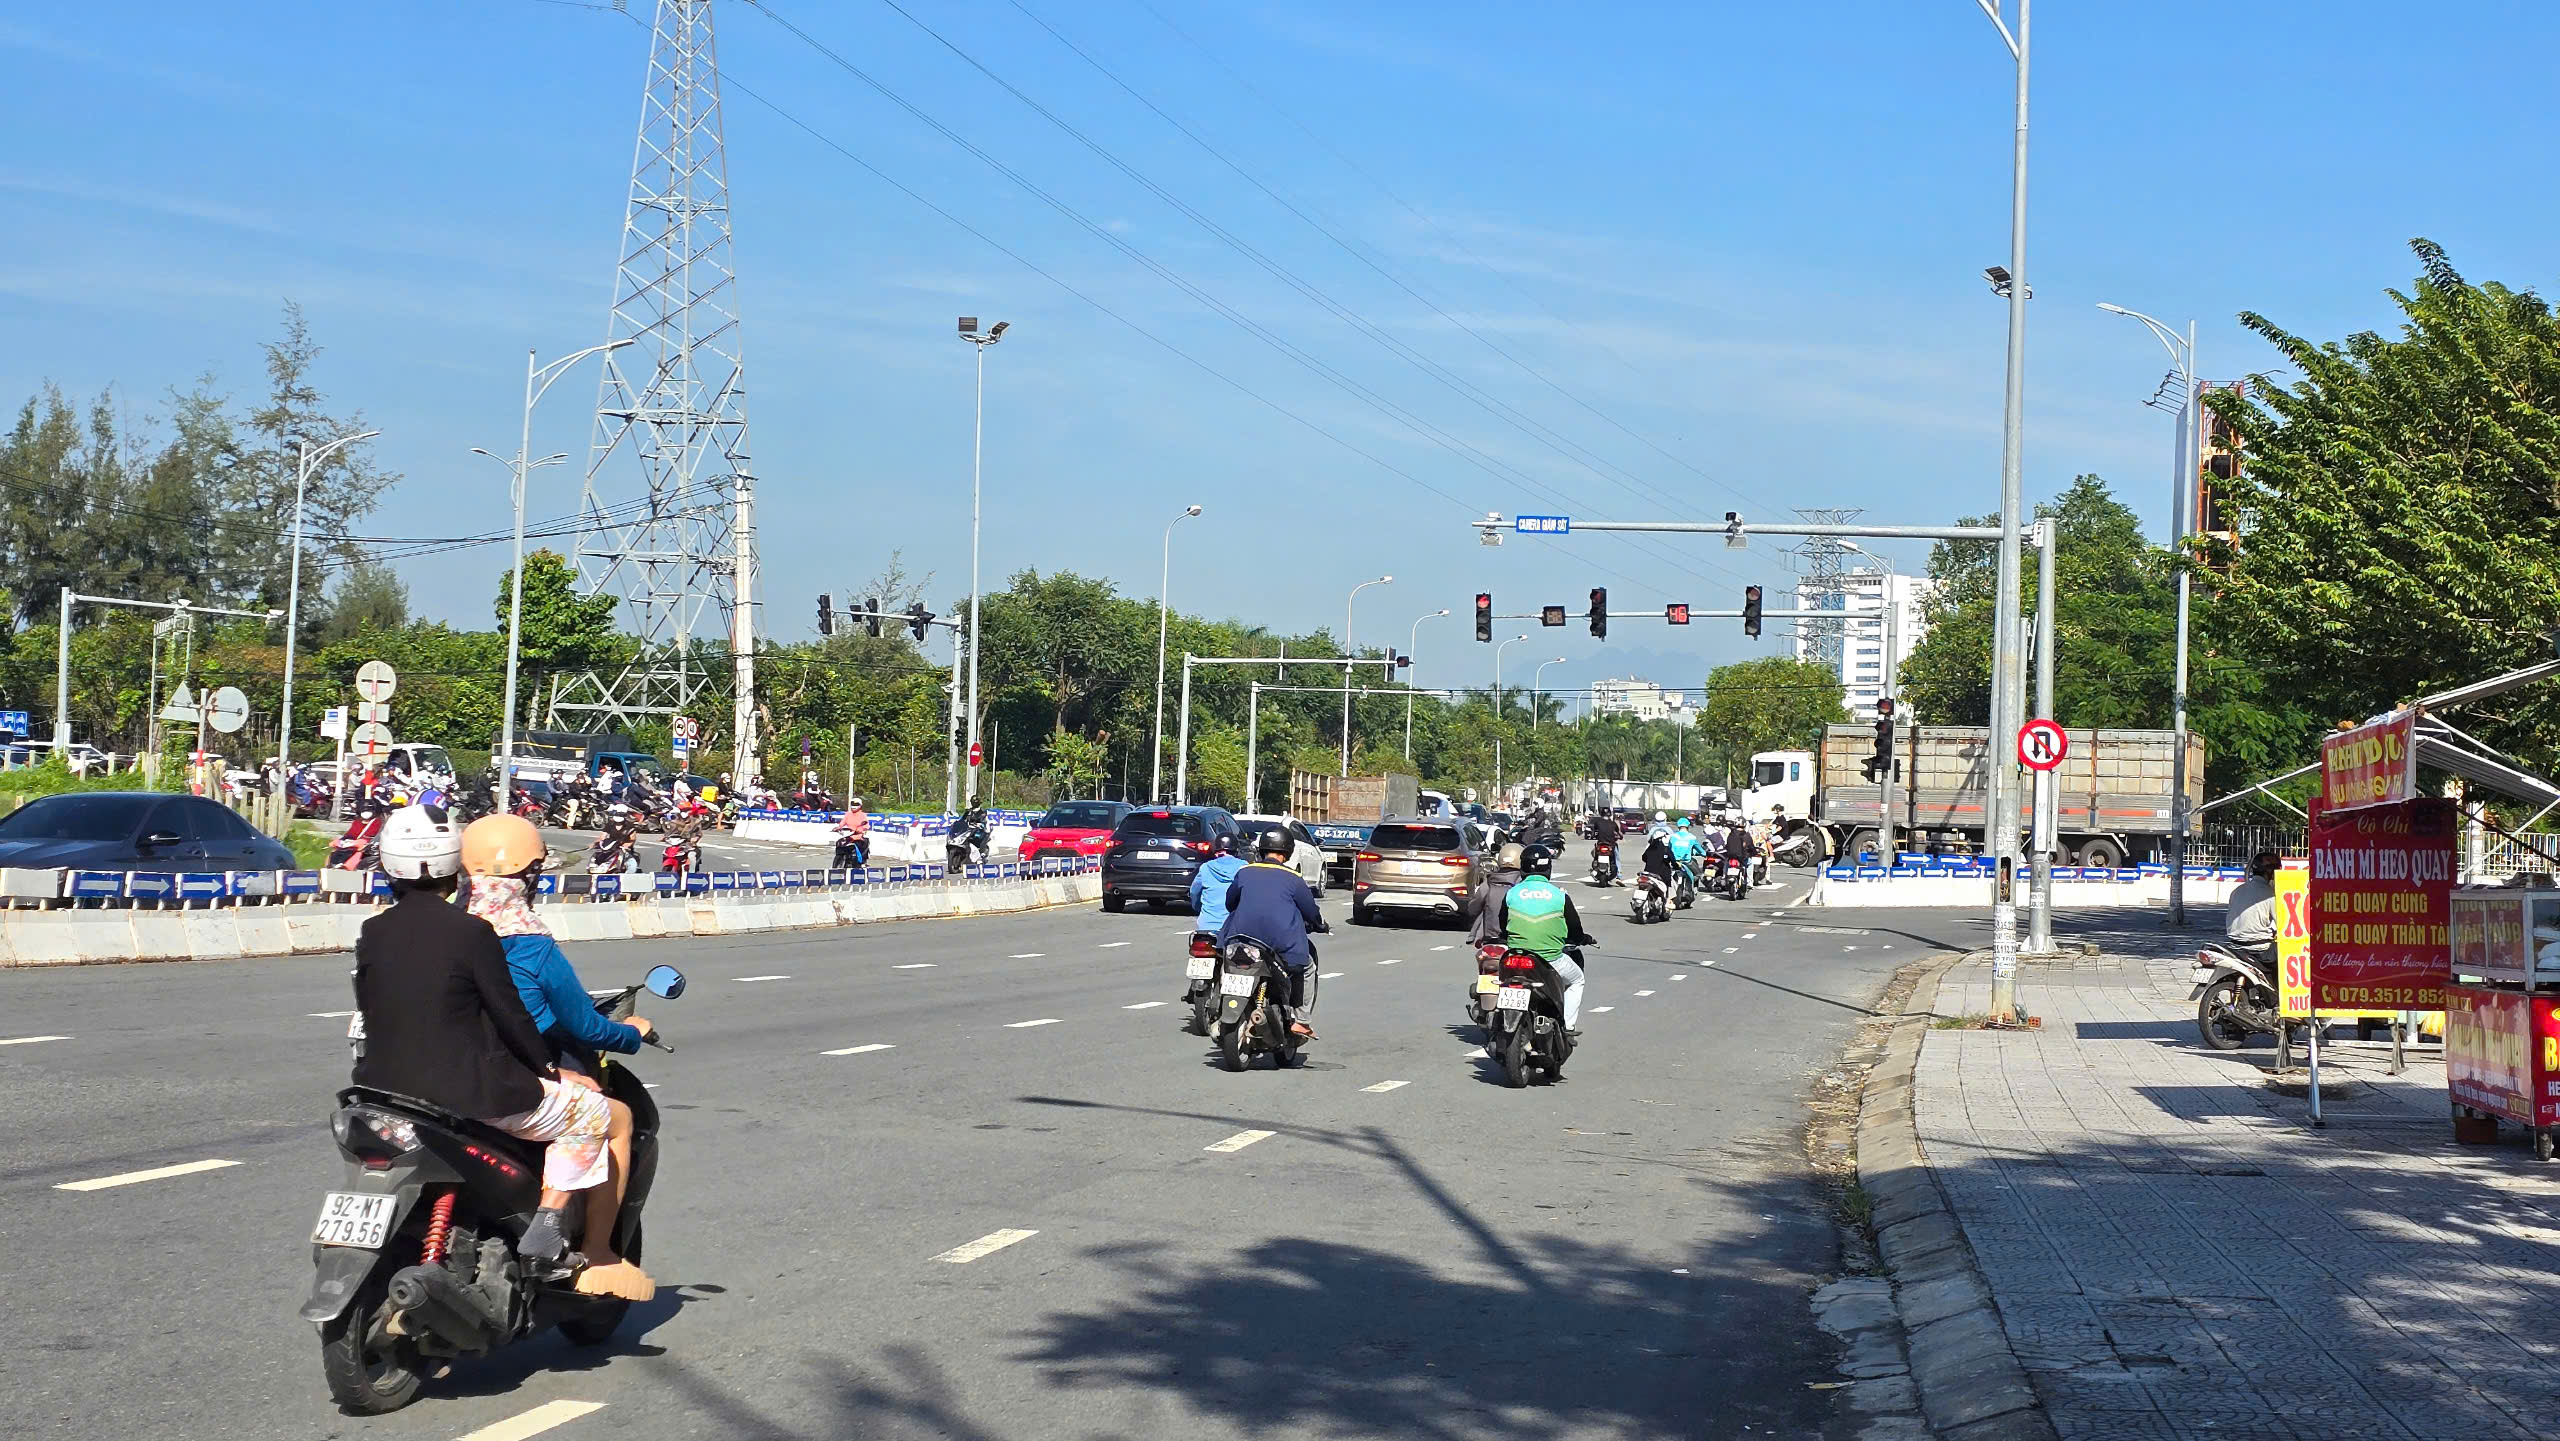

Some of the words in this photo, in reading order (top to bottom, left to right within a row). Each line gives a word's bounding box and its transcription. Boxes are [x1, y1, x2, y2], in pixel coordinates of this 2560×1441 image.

[2315, 840, 2356, 879] BÁNH
[2358, 839, 2376, 880] MÌ
[2379, 849, 2409, 880] HEO
[2411, 849, 2451, 888] QUAY
[1519, 888, 1552, 900] Grab
[2323, 892, 2349, 913] HEO
[2353, 892, 2388, 914] QUAY
[2391, 889, 2428, 914] CÚNG
[2323, 923, 2349, 944] HEO
[2353, 924, 2388, 945] QUAY
[2391, 917, 2426, 946] THẦN
[2339, 987, 2414, 1004] 079.3512
[2418, 988, 2444, 1005] 852
[331, 1195, 384, 1219] 92-N1
[316, 1219, 383, 1245] 279.56
